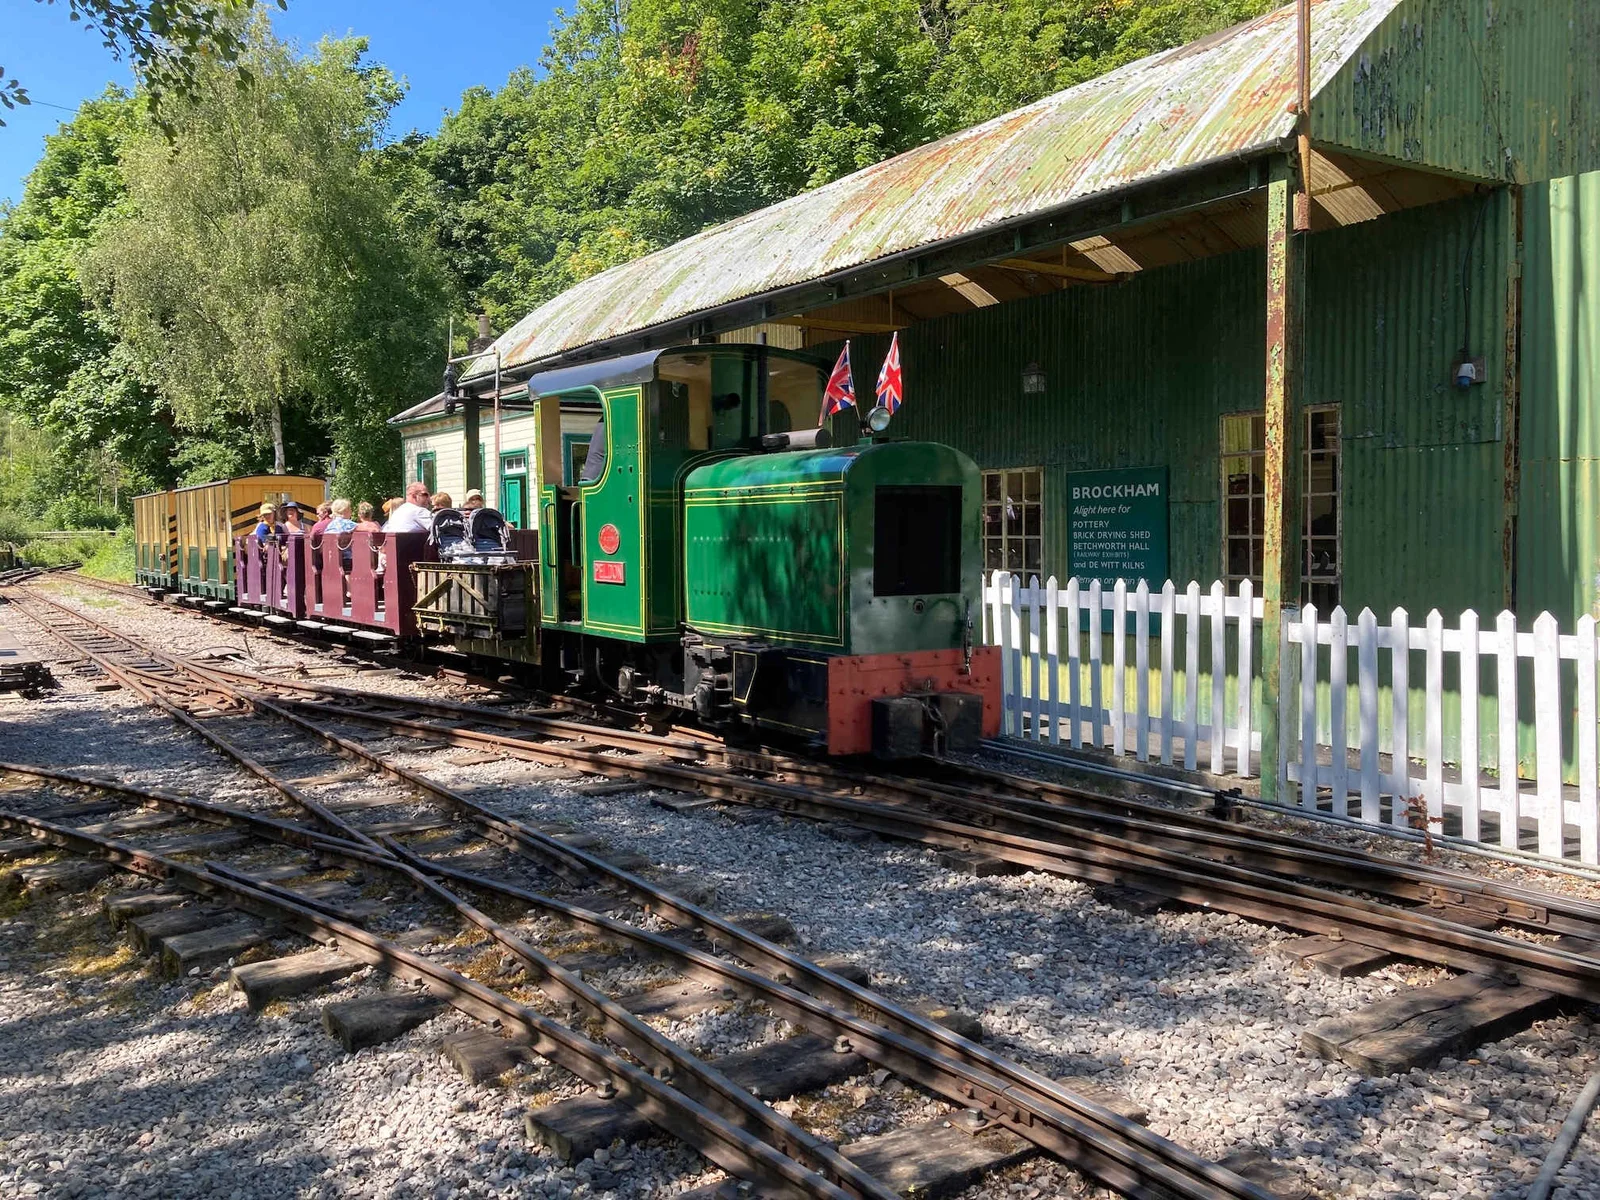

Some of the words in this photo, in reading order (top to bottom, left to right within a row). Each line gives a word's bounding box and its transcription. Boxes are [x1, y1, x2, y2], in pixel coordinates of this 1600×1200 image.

[1072, 483, 1159, 499] BROCKHAM
[1073, 505, 1096, 517] Alight
[1097, 505, 1116, 514] here
[1118, 504, 1131, 513] for
[1073, 520, 1110, 528] POTTERY
[1073, 531, 1095, 539] BRICK
[1097, 531, 1127, 539] DRYING
[1130, 530, 1151, 539] SHED
[1073, 542, 1126, 550] BETCHWORTH
[1129, 542, 1150, 550] HALL
[1089, 561, 1099, 569] DE
[1100, 561, 1120, 569] WITT
[1122, 561, 1145, 570] KILNS
